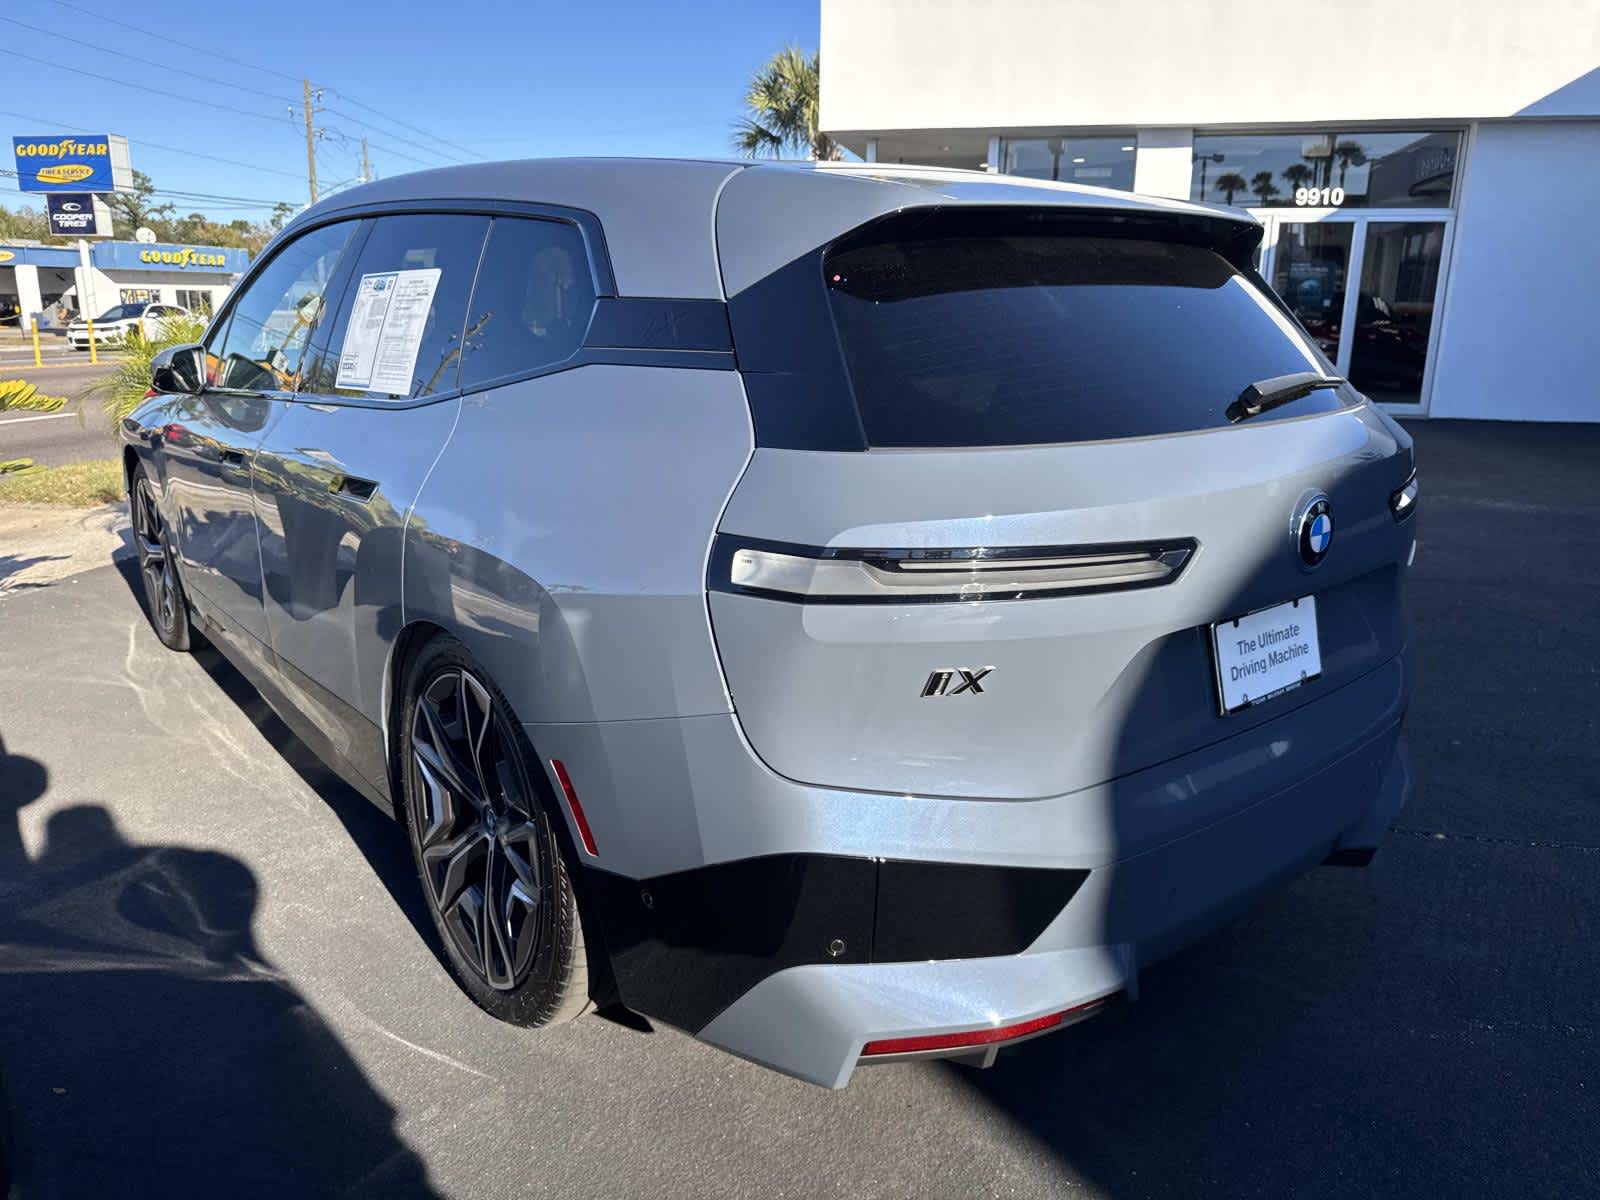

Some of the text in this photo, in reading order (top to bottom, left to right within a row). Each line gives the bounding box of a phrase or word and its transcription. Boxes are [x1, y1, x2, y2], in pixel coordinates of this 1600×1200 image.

[16, 140, 108, 159] GOODYEAR
[1295, 187, 1344, 206] 9910
[53, 213, 93, 221] COOPER
[58, 220, 87, 228] TIRES
[140, 248, 226, 268] GOODYEAR
[1236, 624, 1300, 656] The Ultimate
[1230, 643, 1310, 682] Driving Machine
